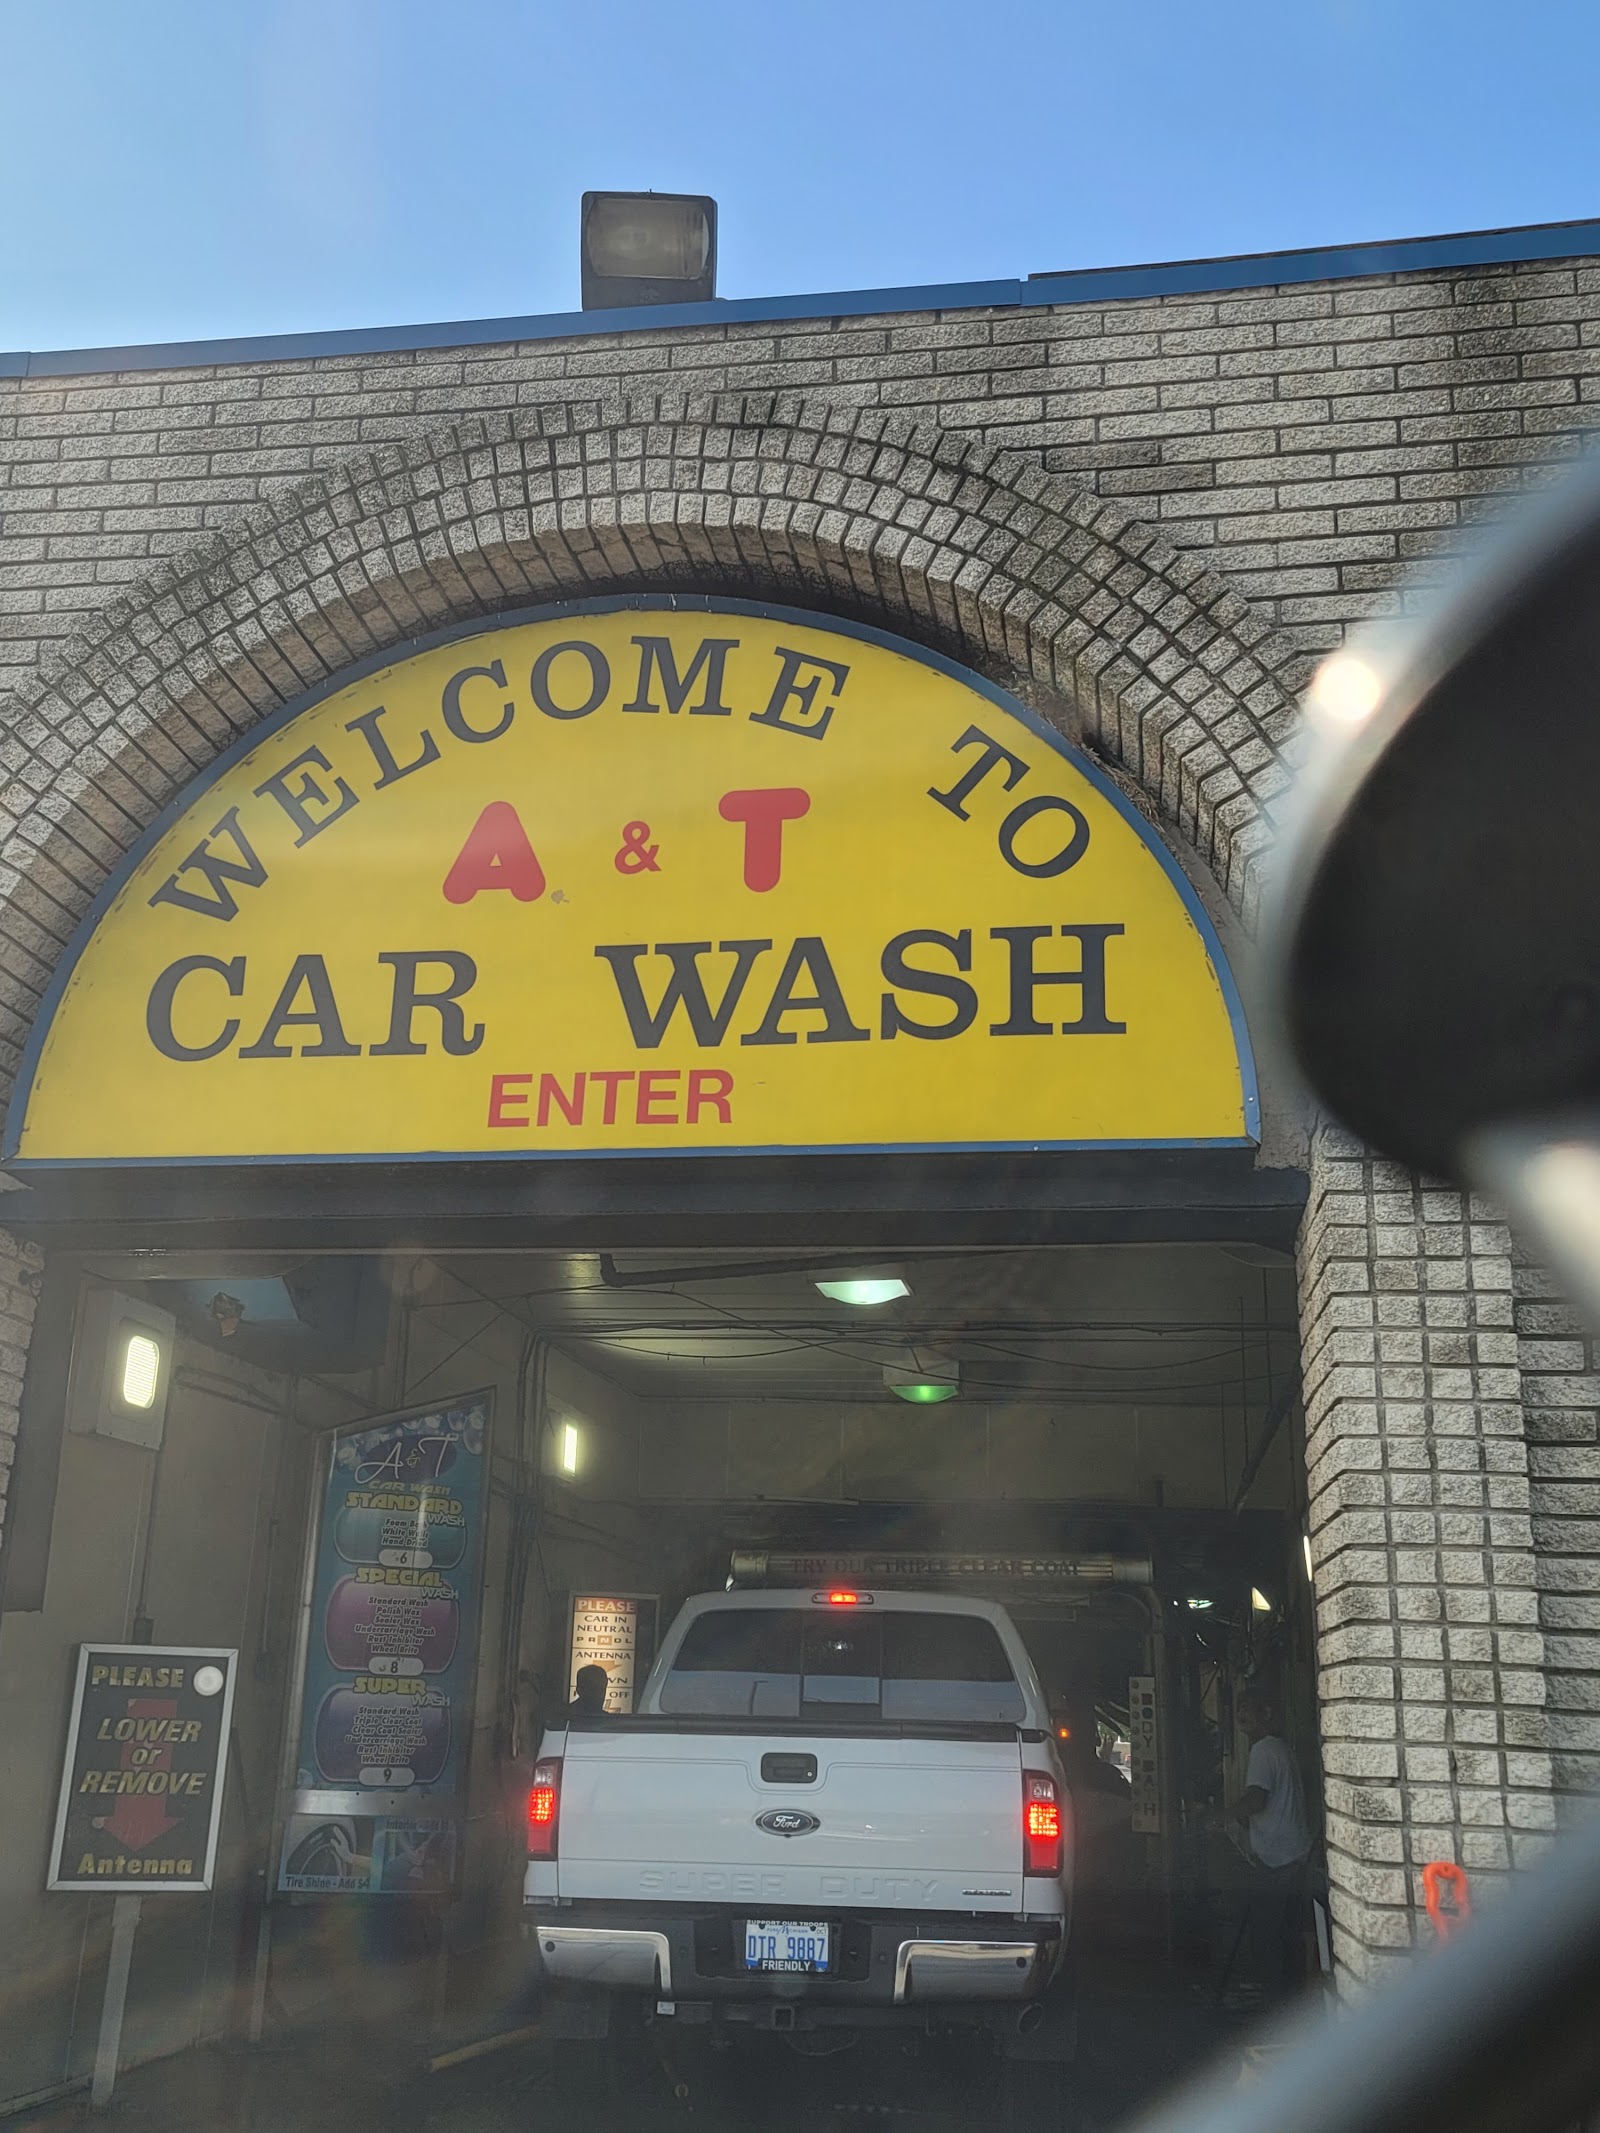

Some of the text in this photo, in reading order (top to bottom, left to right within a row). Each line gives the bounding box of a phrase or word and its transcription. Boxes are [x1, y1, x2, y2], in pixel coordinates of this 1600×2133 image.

[147, 635, 1090, 923] WELCOME TO
[443, 787, 811, 905] A & T
[146, 923, 1128, 1062] CAR WASH
[487, 1070, 735, 1129] ENTER
[355, 1442, 404, 1484] A
[418, 1433, 459, 1478] T
[368, 1480, 451, 1496] CAR WASH
[345, 1491, 463, 1516] STANDARD
[386, 1519, 428, 1529] Foam Bah
[427, 1513, 465, 1526] WASH
[382, 1528, 405, 1537] White
[382, 1537, 403, 1546] Hand
[791, 1559, 827, 1574] TRY
[834, 1558, 874, 1574] OUR
[882, 1559, 949, 1575] TRIPLE
[1031, 1560, 1081, 1576] COAT
[354, 1567, 444, 1588] SPECIAL
[420, 1587, 459, 1600] WASH
[369, 1596, 429, 1607] Standard Wash
[577, 1600, 635, 1612] PLEASE
[376, 1607, 421, 1616] Polish Wax
[375, 1616, 420, 1625] Sealer Wax
[584, 1615, 609, 1623] CAR
[355, 1625, 435, 1636] Undercarriage Wash
[577, 1625, 632, 1633] NEUTRAL
[368, 1635, 424, 1645] Rust Inhibitor
[371, 1645, 419, 1654] Wheel Brite
[575, 1651, 631, 1660] ANTENNA
[91, 1665, 184, 1688] PLEASE
[353, 1676, 428, 1696] SUPER
[411, 1695, 450, 1707] WASH
[359, 1707, 420, 1716] Standard Wash
[354, 1716, 422, 1726] Triple Clear Coat
[97, 1718, 202, 1743] LOWER
[352, 1726, 422, 1736] Clear Coat Sealer
[345, 1735, 427, 1746] Undercarriage Wash
[358, 1745, 415, 1755] Rust Inhibitor
[131, 1748, 162, 1765] or
[362, 1755, 410, 1764] Wheel Brite
[80, 1771, 206, 1795] REMOVE
[773, 1815, 801, 1828] Ford
[77, 1853, 192, 1874] Antenna
[286, 1876, 303, 1888] Tire
[306, 1876, 331, 1888] Shine
[339, 1877, 356, 1888] Add
[639, 1870, 940, 1903] SUPER DUTY
[748, 1935, 825, 1960] DTR 9887
[762, 1960, 811, 1971] FRIENDLY
